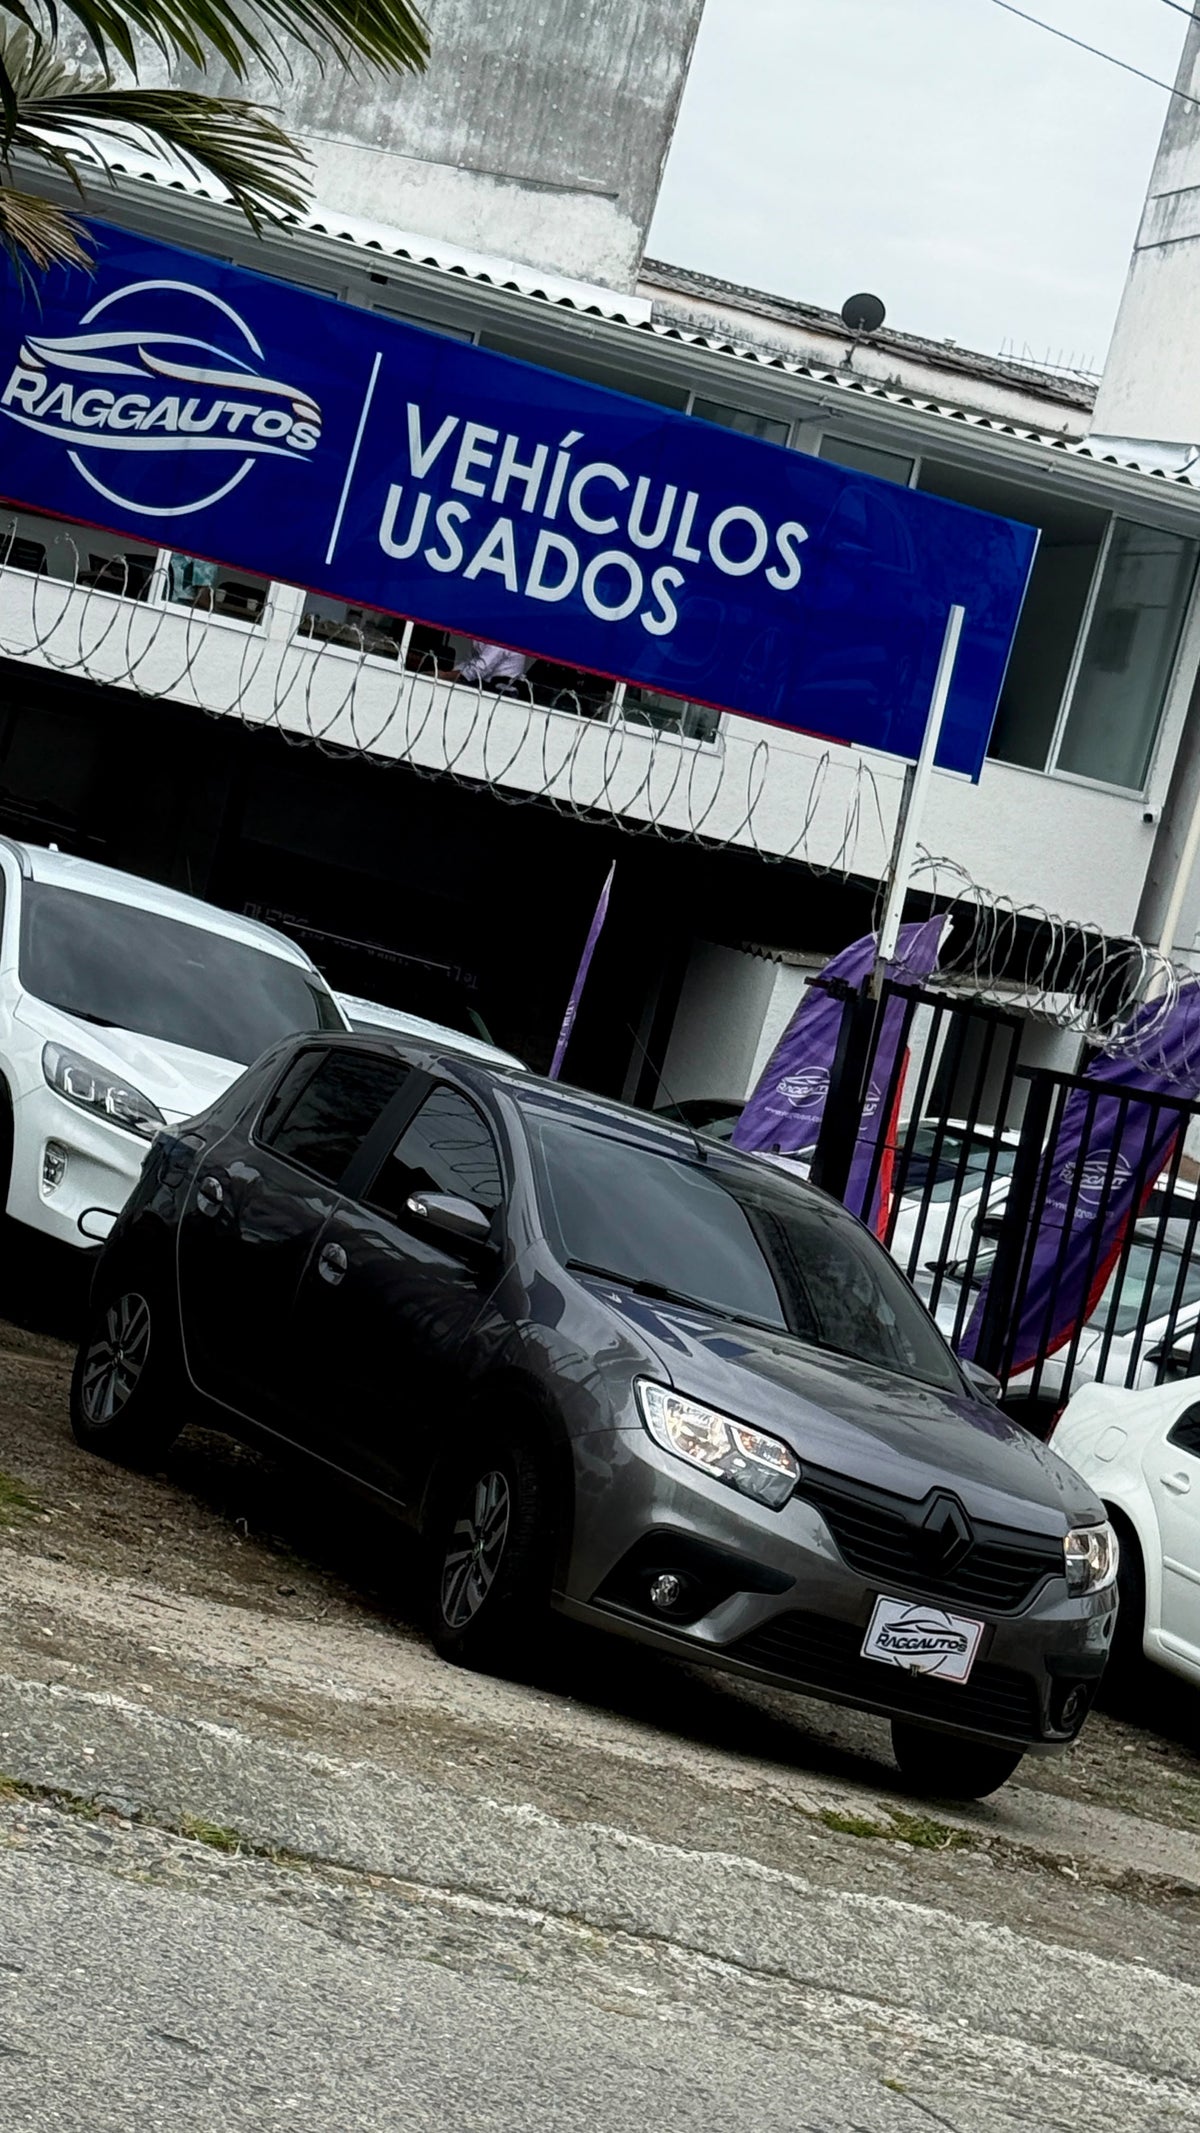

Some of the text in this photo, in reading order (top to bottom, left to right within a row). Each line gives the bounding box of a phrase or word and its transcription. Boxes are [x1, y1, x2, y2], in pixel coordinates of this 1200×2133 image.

[0, 365, 322, 451] RAGGAUTOS
[407, 402, 809, 590] VEHÍCULOS
[379, 483, 685, 636] USADOS
[875, 1632, 968, 1653] RAGGAUTOS
